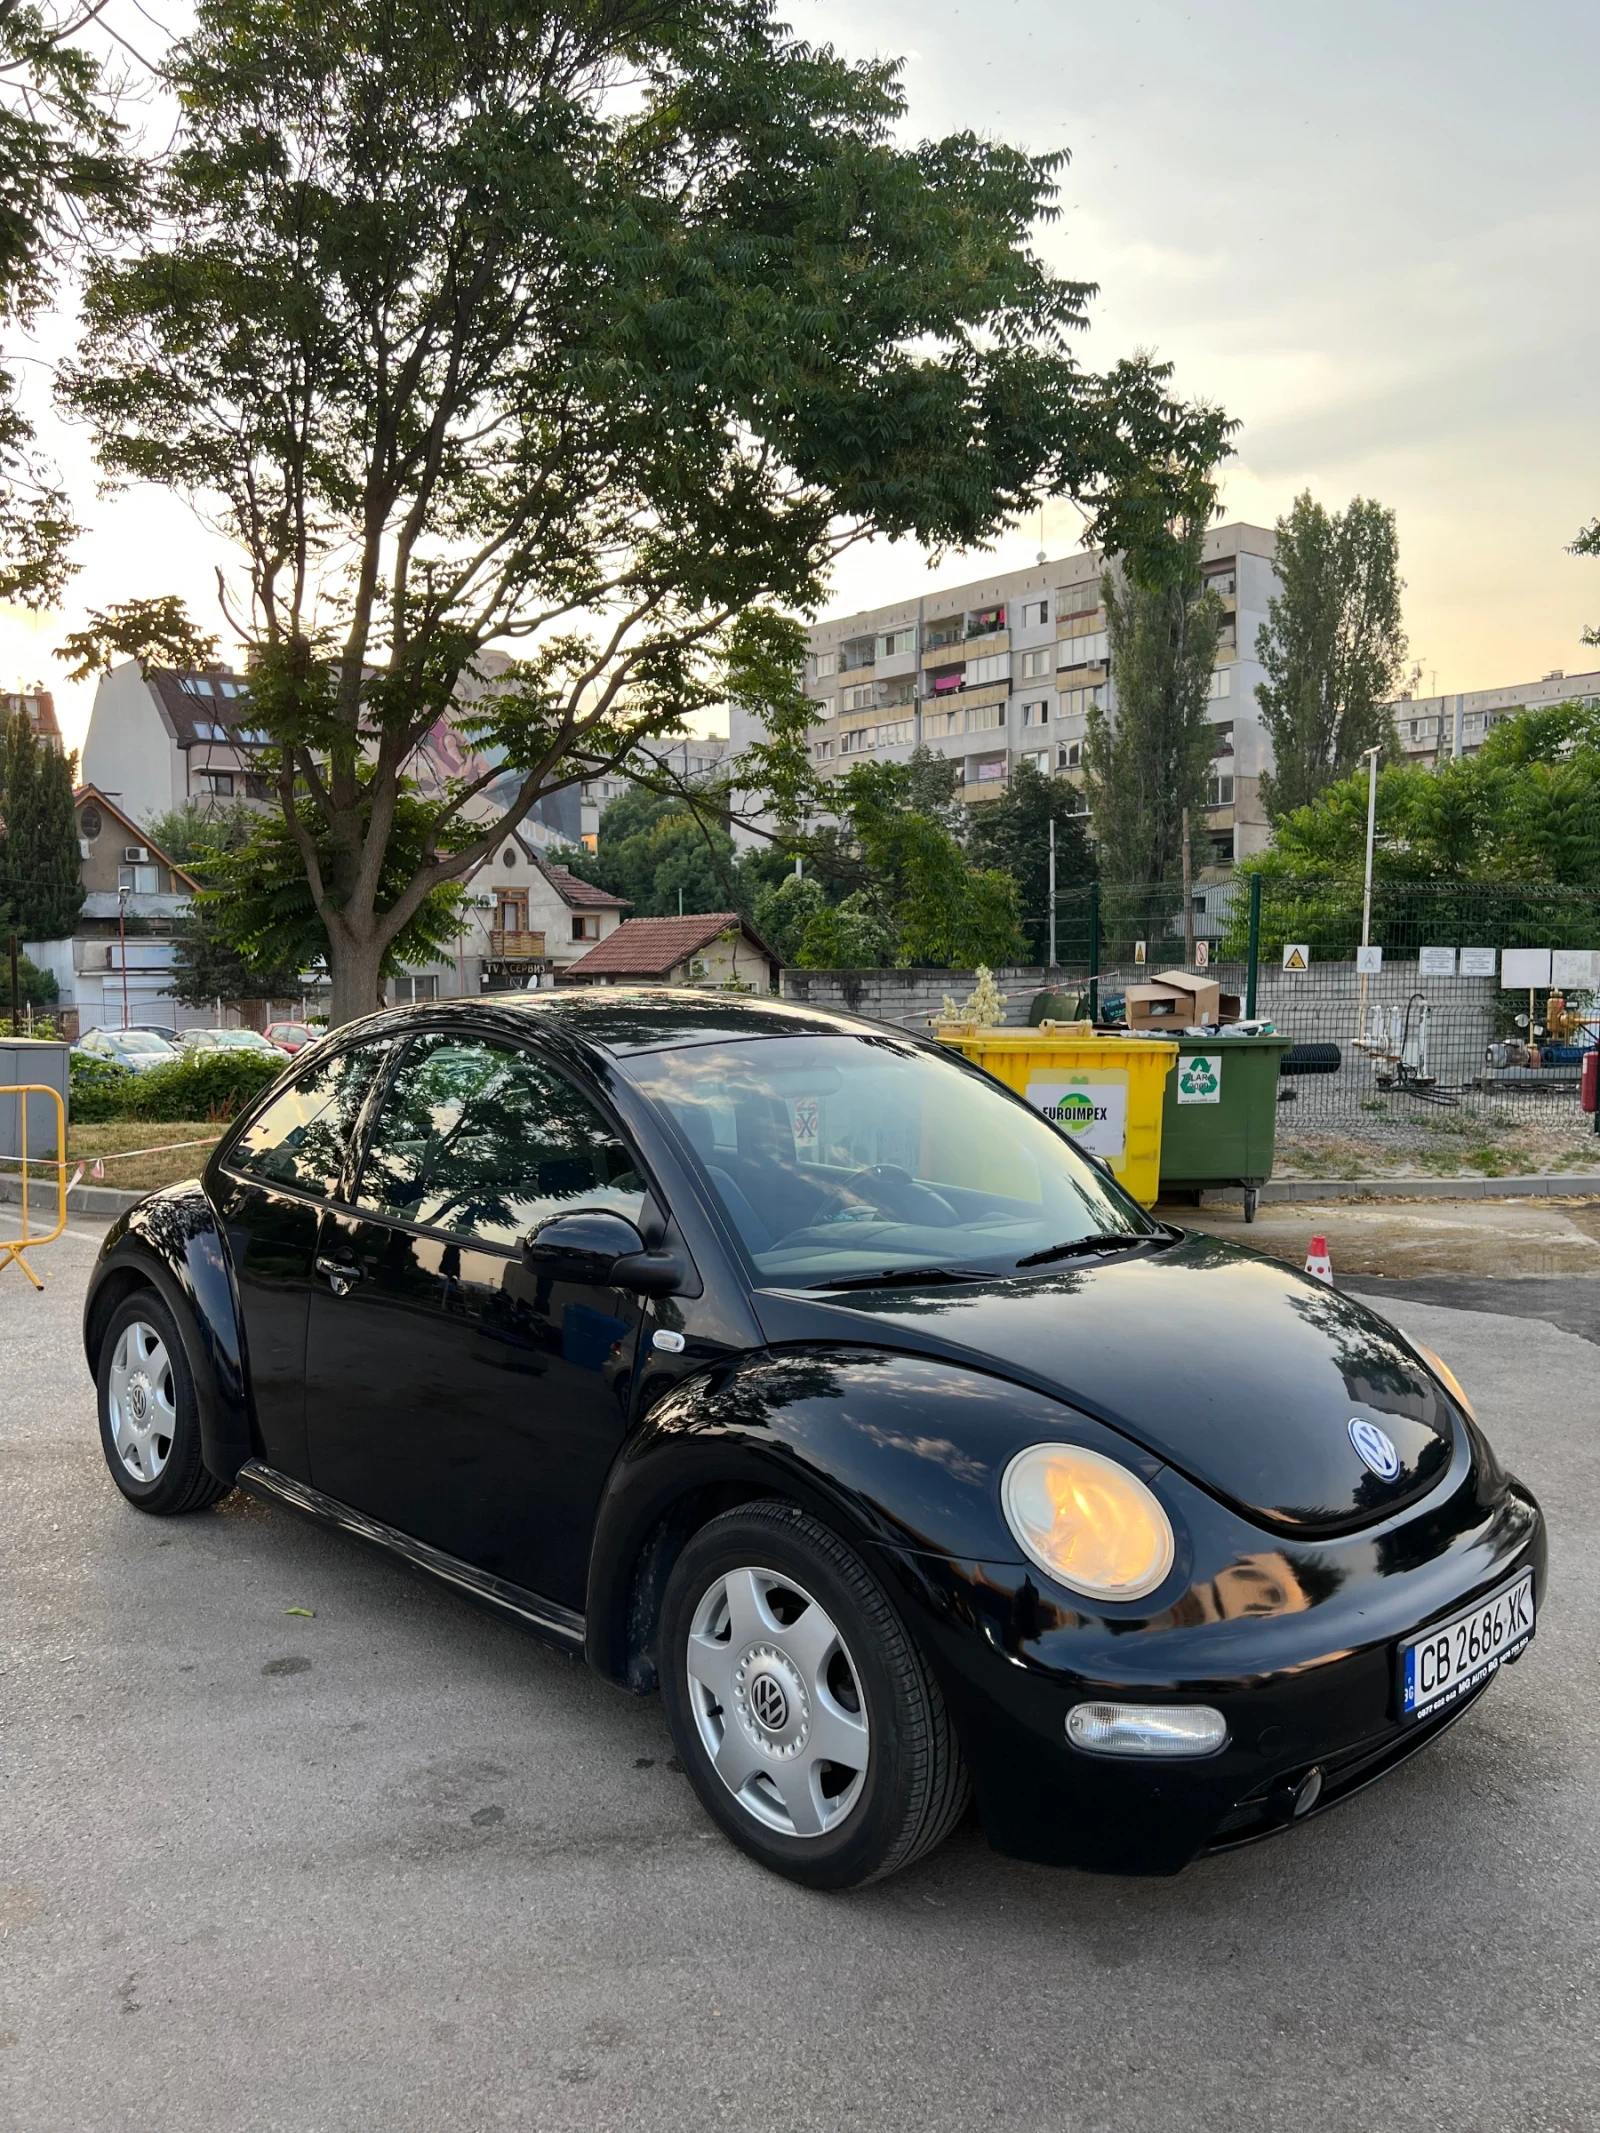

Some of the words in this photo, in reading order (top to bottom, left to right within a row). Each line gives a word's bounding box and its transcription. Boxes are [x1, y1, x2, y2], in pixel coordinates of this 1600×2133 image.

[485, 963, 500, 973] TV
[510, 964, 546, 973] СЕРВИЗ
[1184, 1073, 1215, 1082] ALARA
[1421, 1636, 1450, 1693] CB
[1456, 1603, 1502, 1674] 2686
[1507, 1583, 1528, 1638] XK
[1471, 1667, 1488, 1685] AUTO
